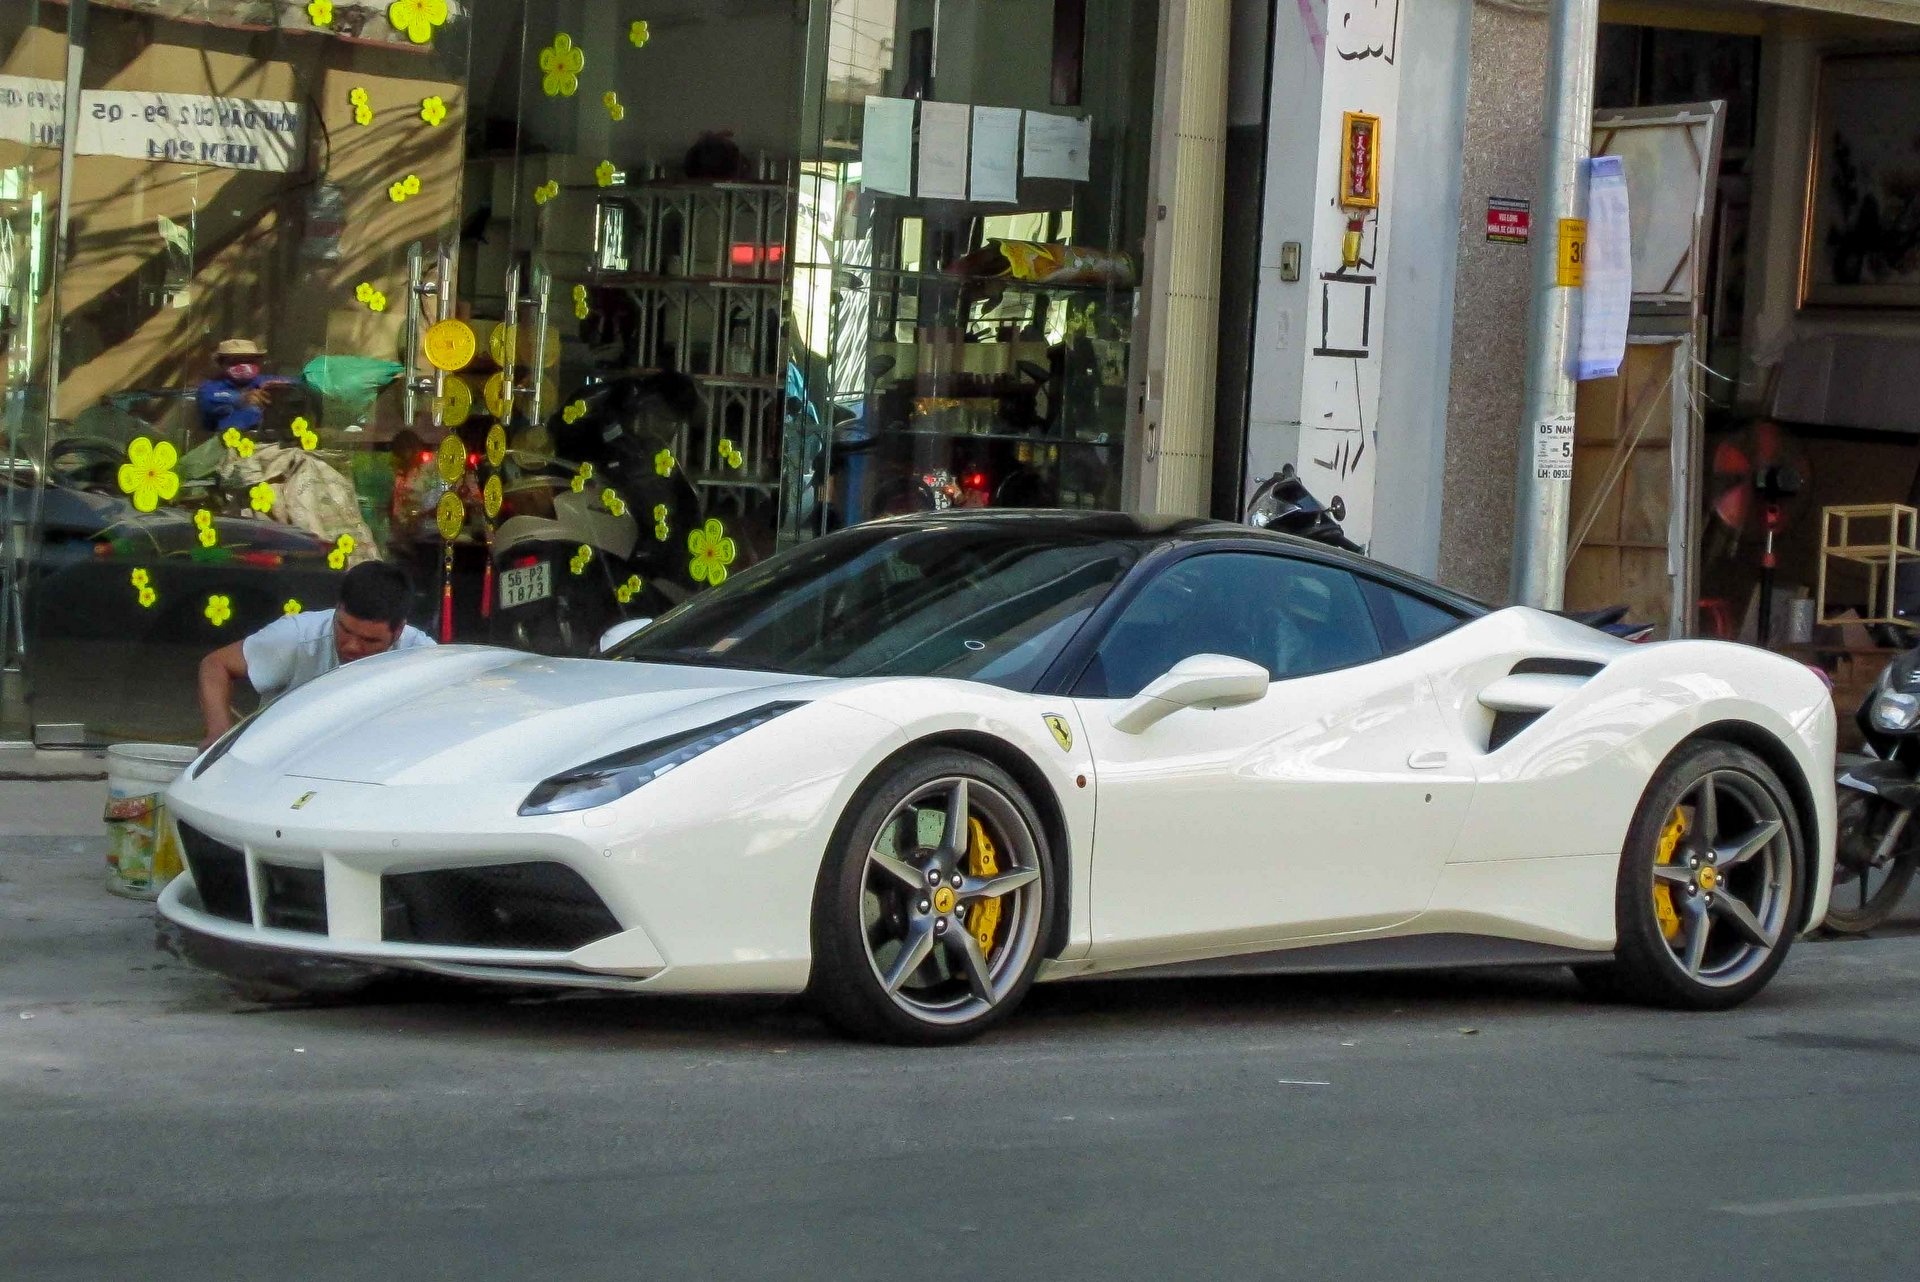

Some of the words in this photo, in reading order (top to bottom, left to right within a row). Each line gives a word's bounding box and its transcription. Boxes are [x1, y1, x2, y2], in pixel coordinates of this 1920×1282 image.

[1540, 425, 1552, 434] 05
[1537, 469, 1551, 478] LH:
[508, 581, 544, 604] 1873
